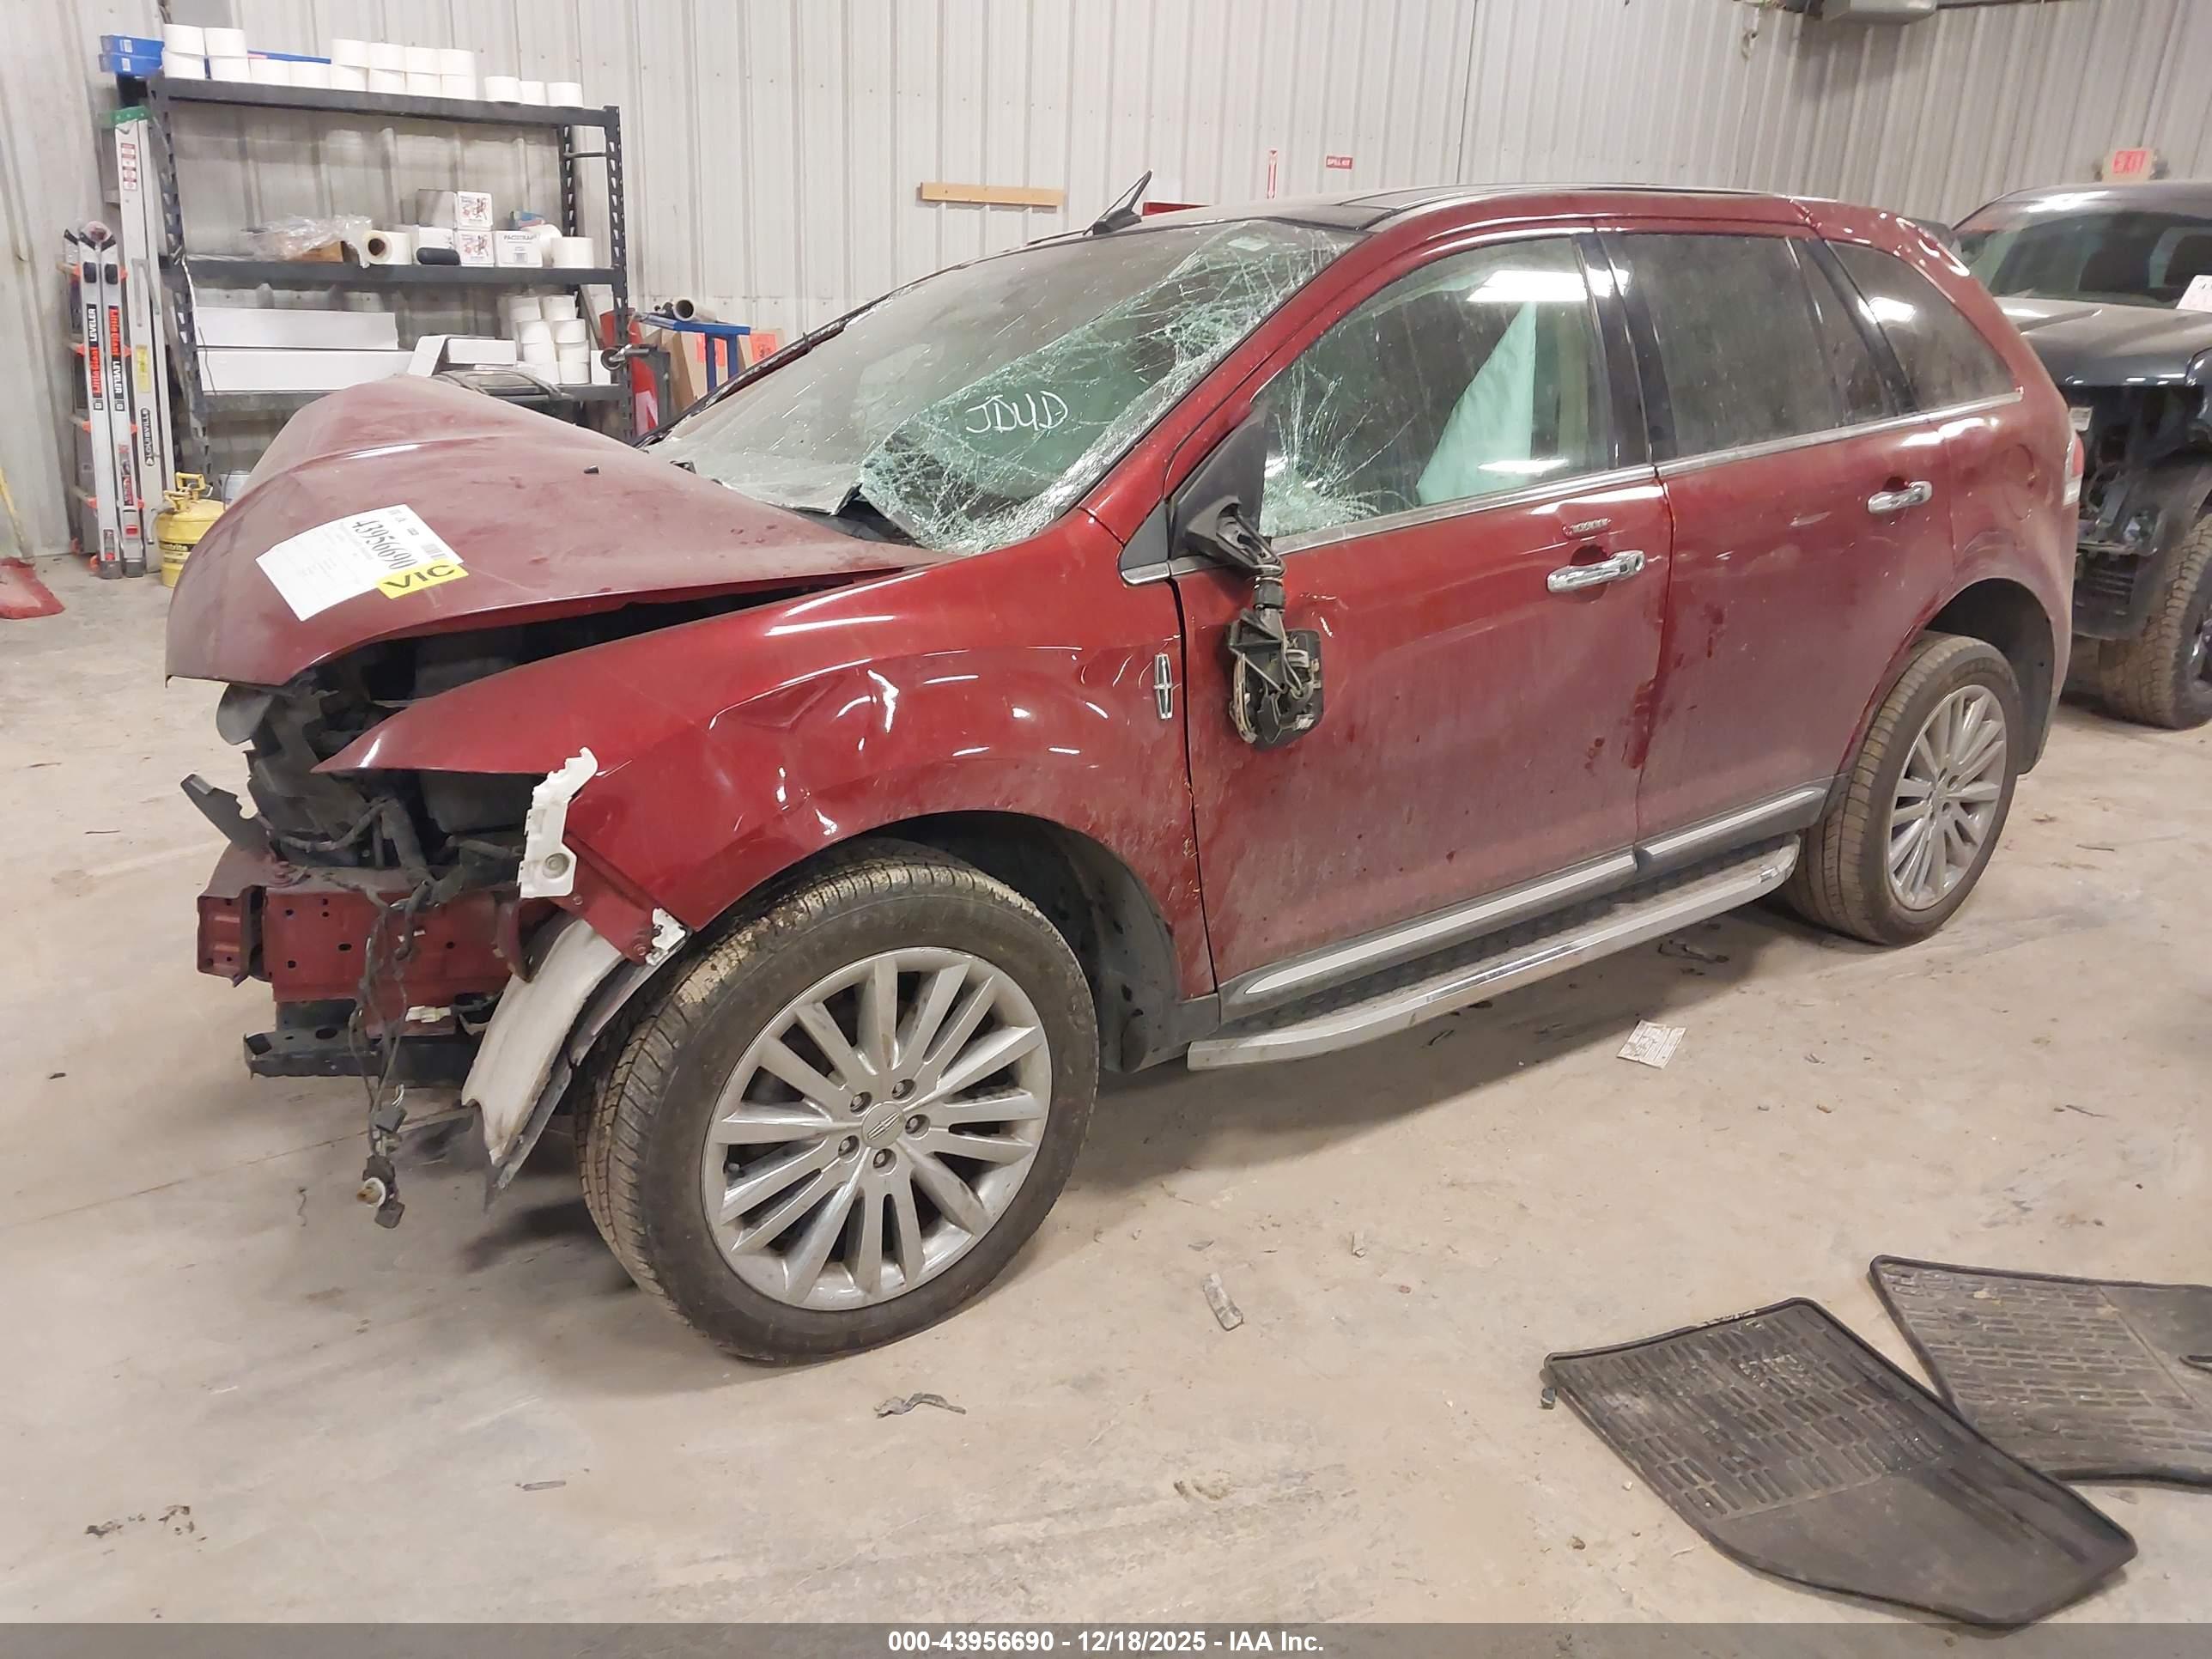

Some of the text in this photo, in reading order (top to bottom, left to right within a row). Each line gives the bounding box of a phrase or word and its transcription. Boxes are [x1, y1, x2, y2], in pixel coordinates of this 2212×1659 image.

[2113, 149, 2146, 173] EXIT
[88, 308, 97, 342] LEVELER
[113, 361, 123, 393] LEVELER
[142, 409, 153, 458] LOUISVILLE
[351, 520, 418, 569] 43956690
[383, 564, 455, 588] VIC
